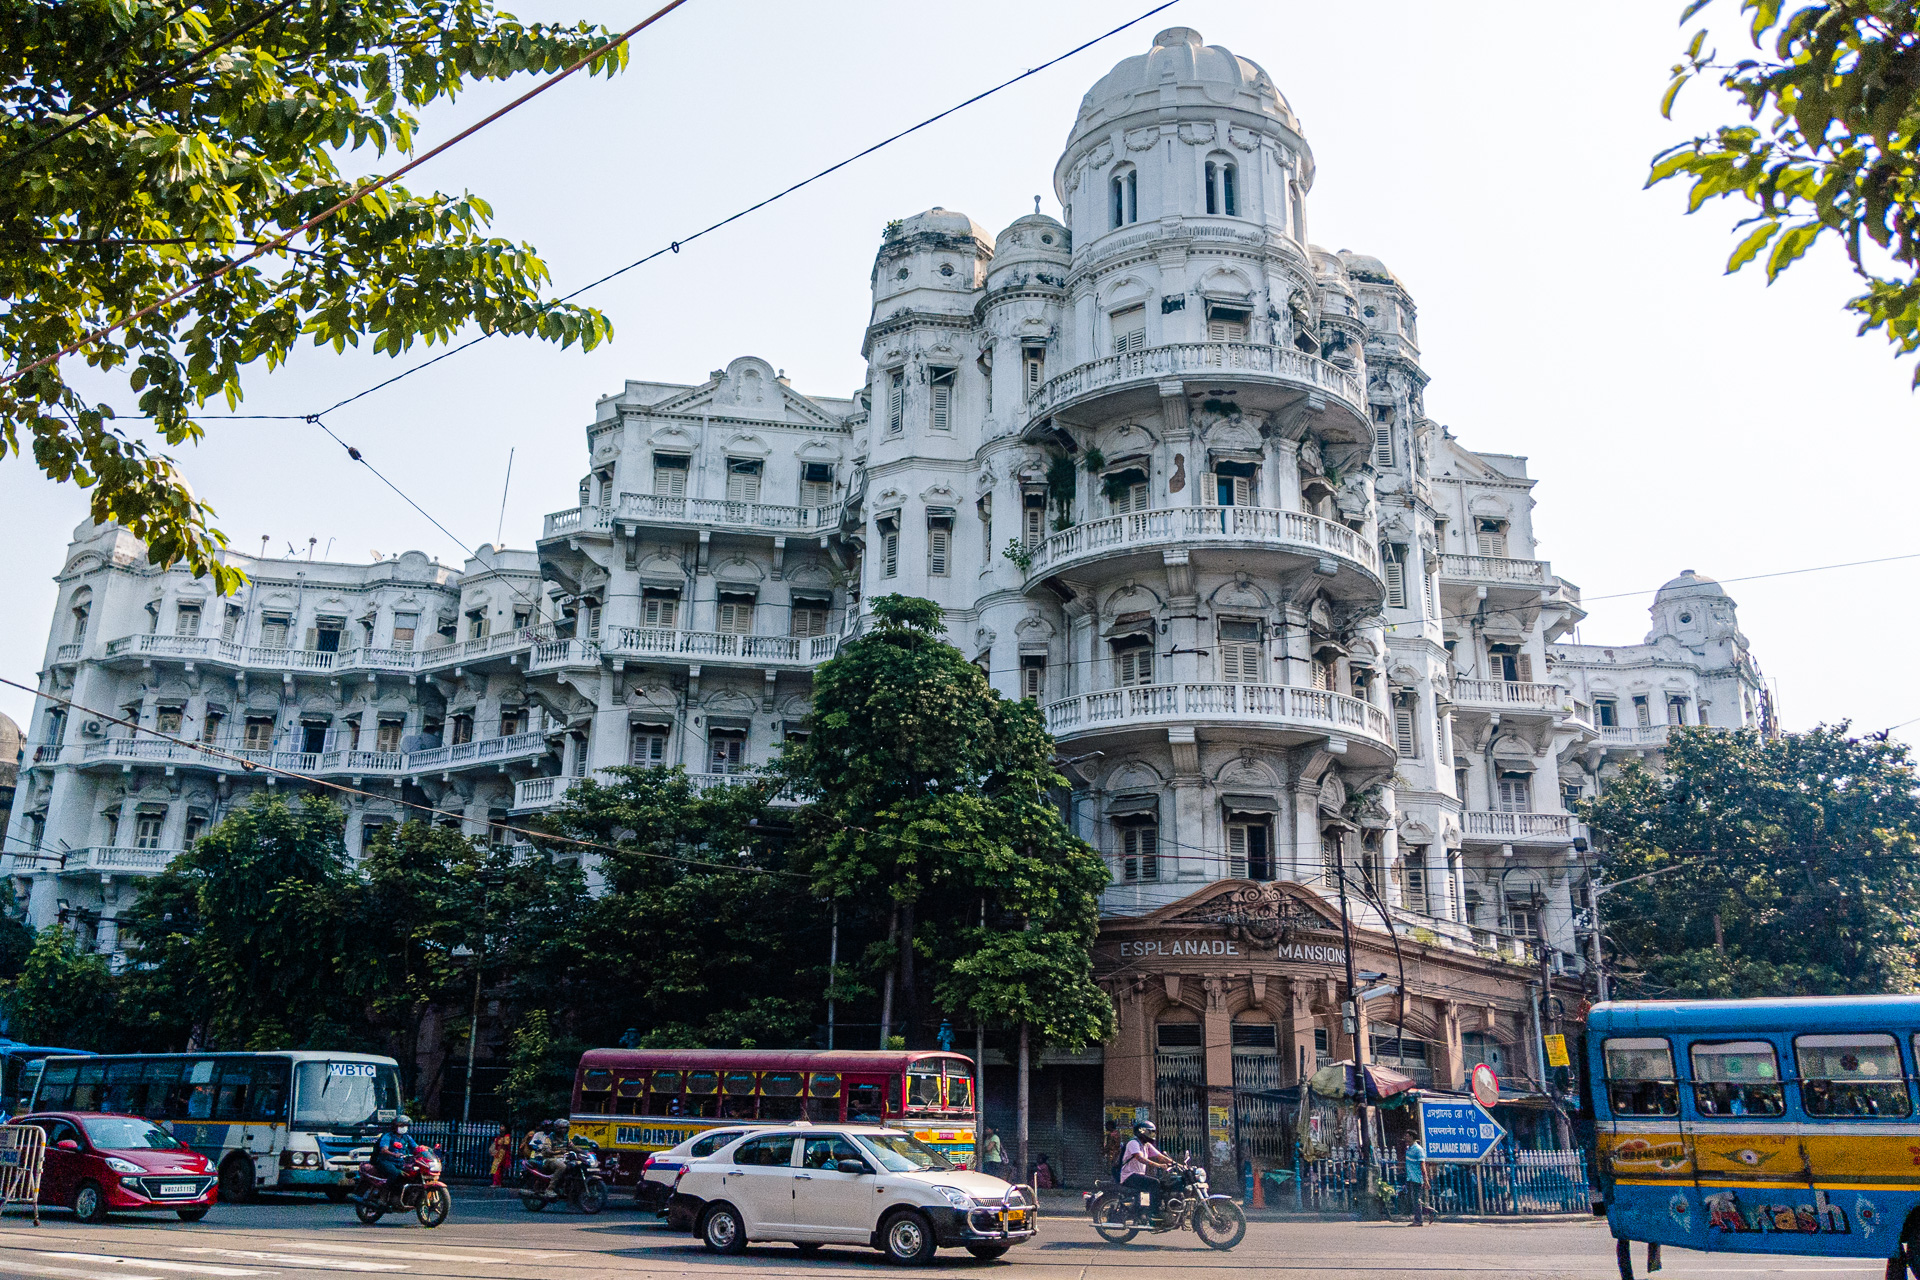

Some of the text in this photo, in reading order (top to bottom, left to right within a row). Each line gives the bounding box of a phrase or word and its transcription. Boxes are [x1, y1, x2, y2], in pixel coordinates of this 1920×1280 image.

[1120, 940, 1239, 957] ESPLANADE
[330, 1064, 374, 1077] WBTC
[1428, 1142, 1459, 1154] ESPLANADE
[1459, 1142, 1471, 1154] ROW
